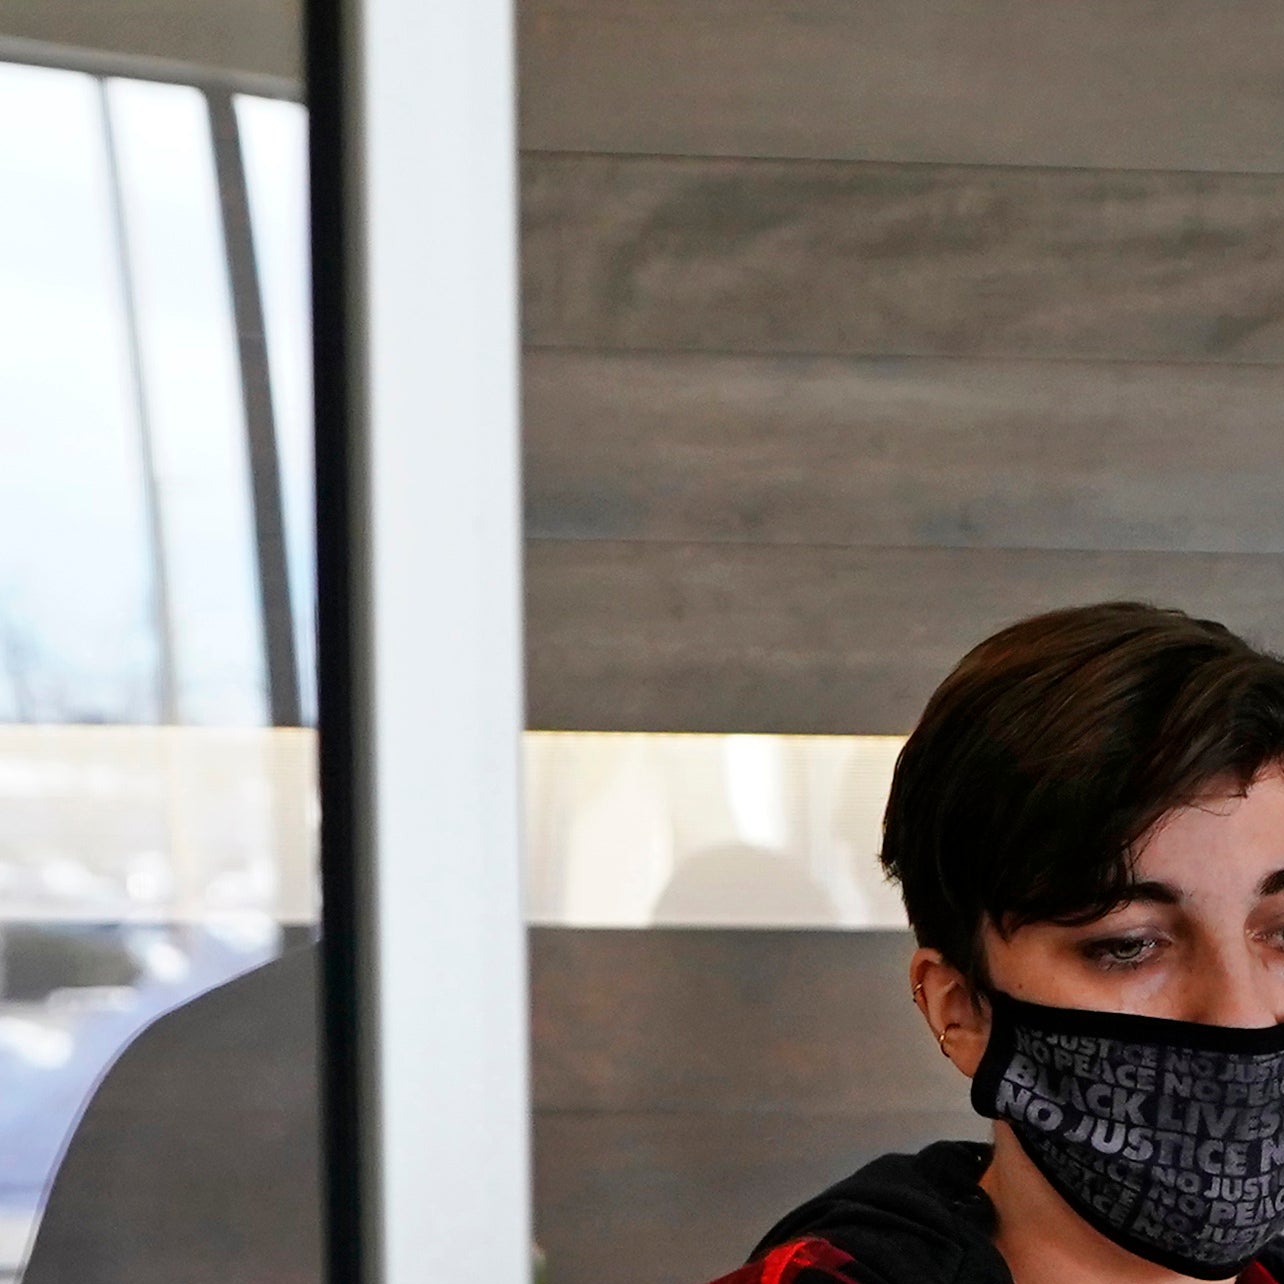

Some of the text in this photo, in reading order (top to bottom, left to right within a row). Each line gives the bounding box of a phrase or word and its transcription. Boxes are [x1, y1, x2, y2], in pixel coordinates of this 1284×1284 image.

[1004, 1053, 1146, 1126] BLACK
[1157, 1095, 1281, 1140] LIVES
[1054, 1048, 1157, 1091] PEACE
[1163, 1072, 1221, 1101] NO
[996, 1079, 1064, 1131] NO
[1063, 1115, 1248, 1175] JUSTICE
[1151, 1166, 1201, 1193] NO
